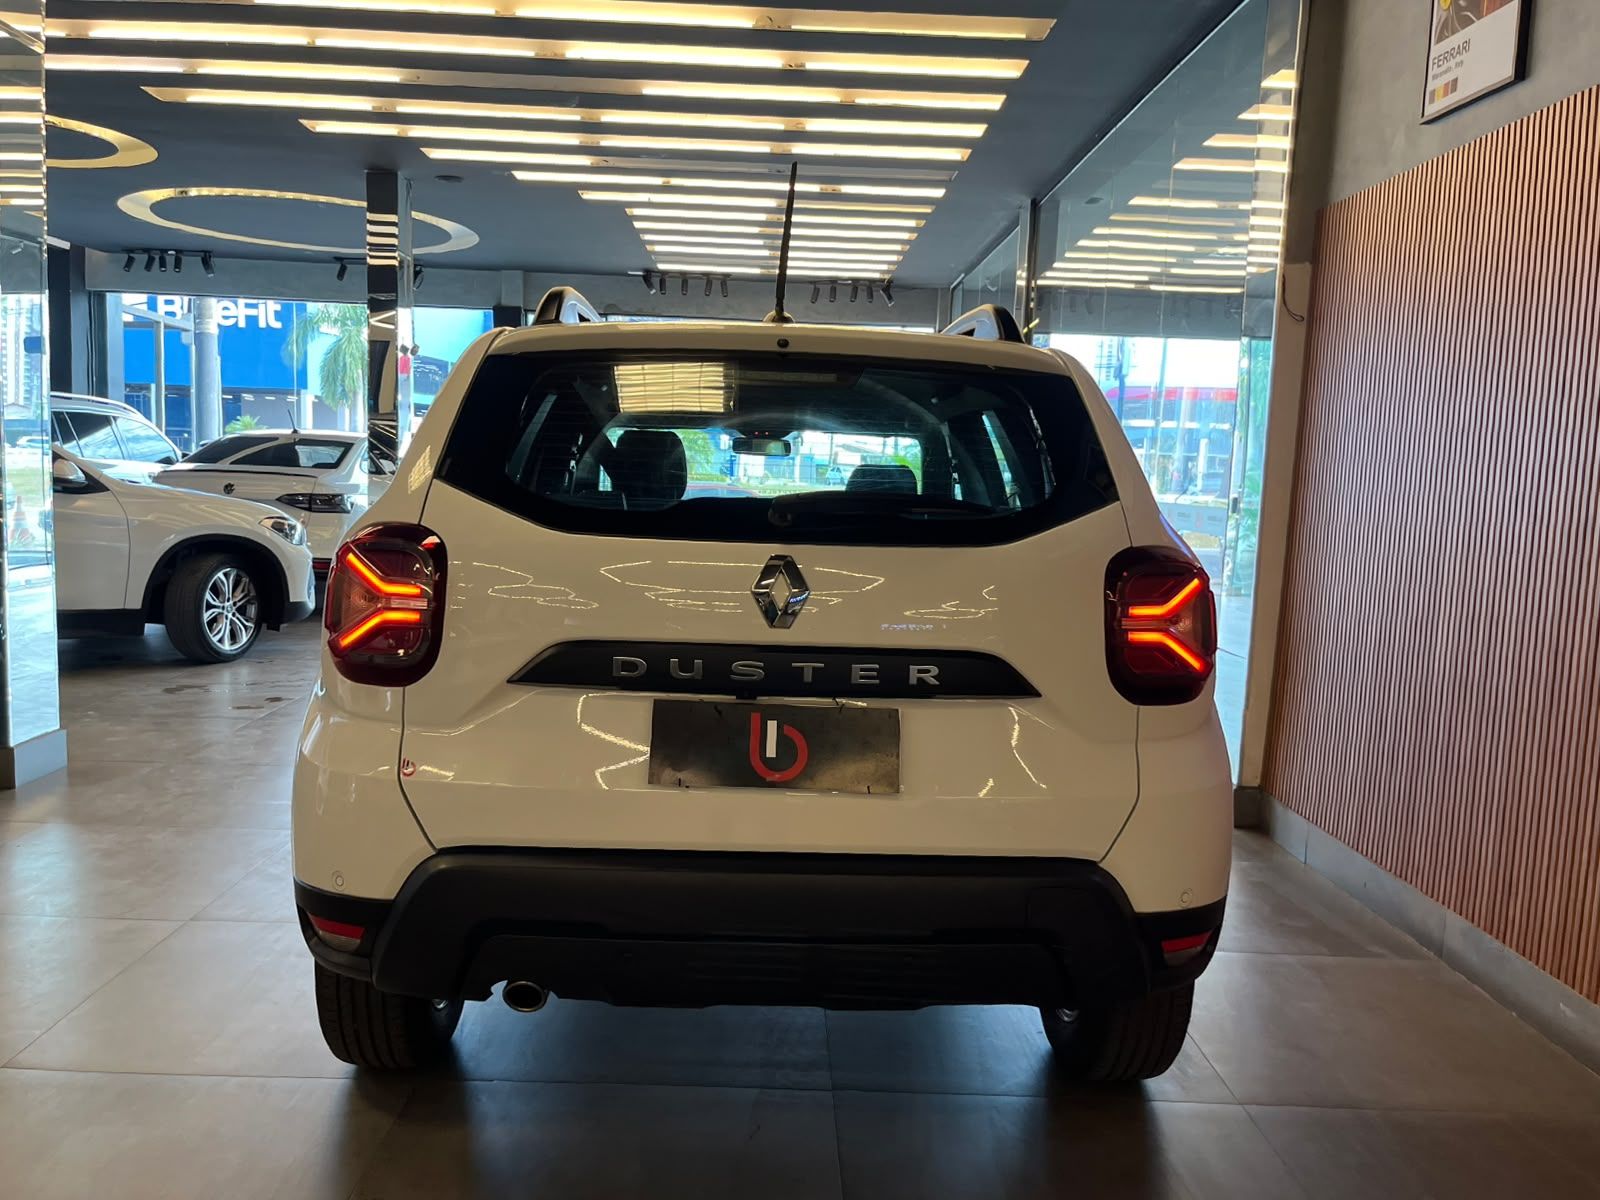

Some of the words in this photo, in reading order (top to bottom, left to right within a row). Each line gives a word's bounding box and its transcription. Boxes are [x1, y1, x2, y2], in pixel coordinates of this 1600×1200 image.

[1431, 38, 1471, 71] FERRARI
[157, 295, 283, 329] BleFit
[612, 656, 941, 686] DUSTER
